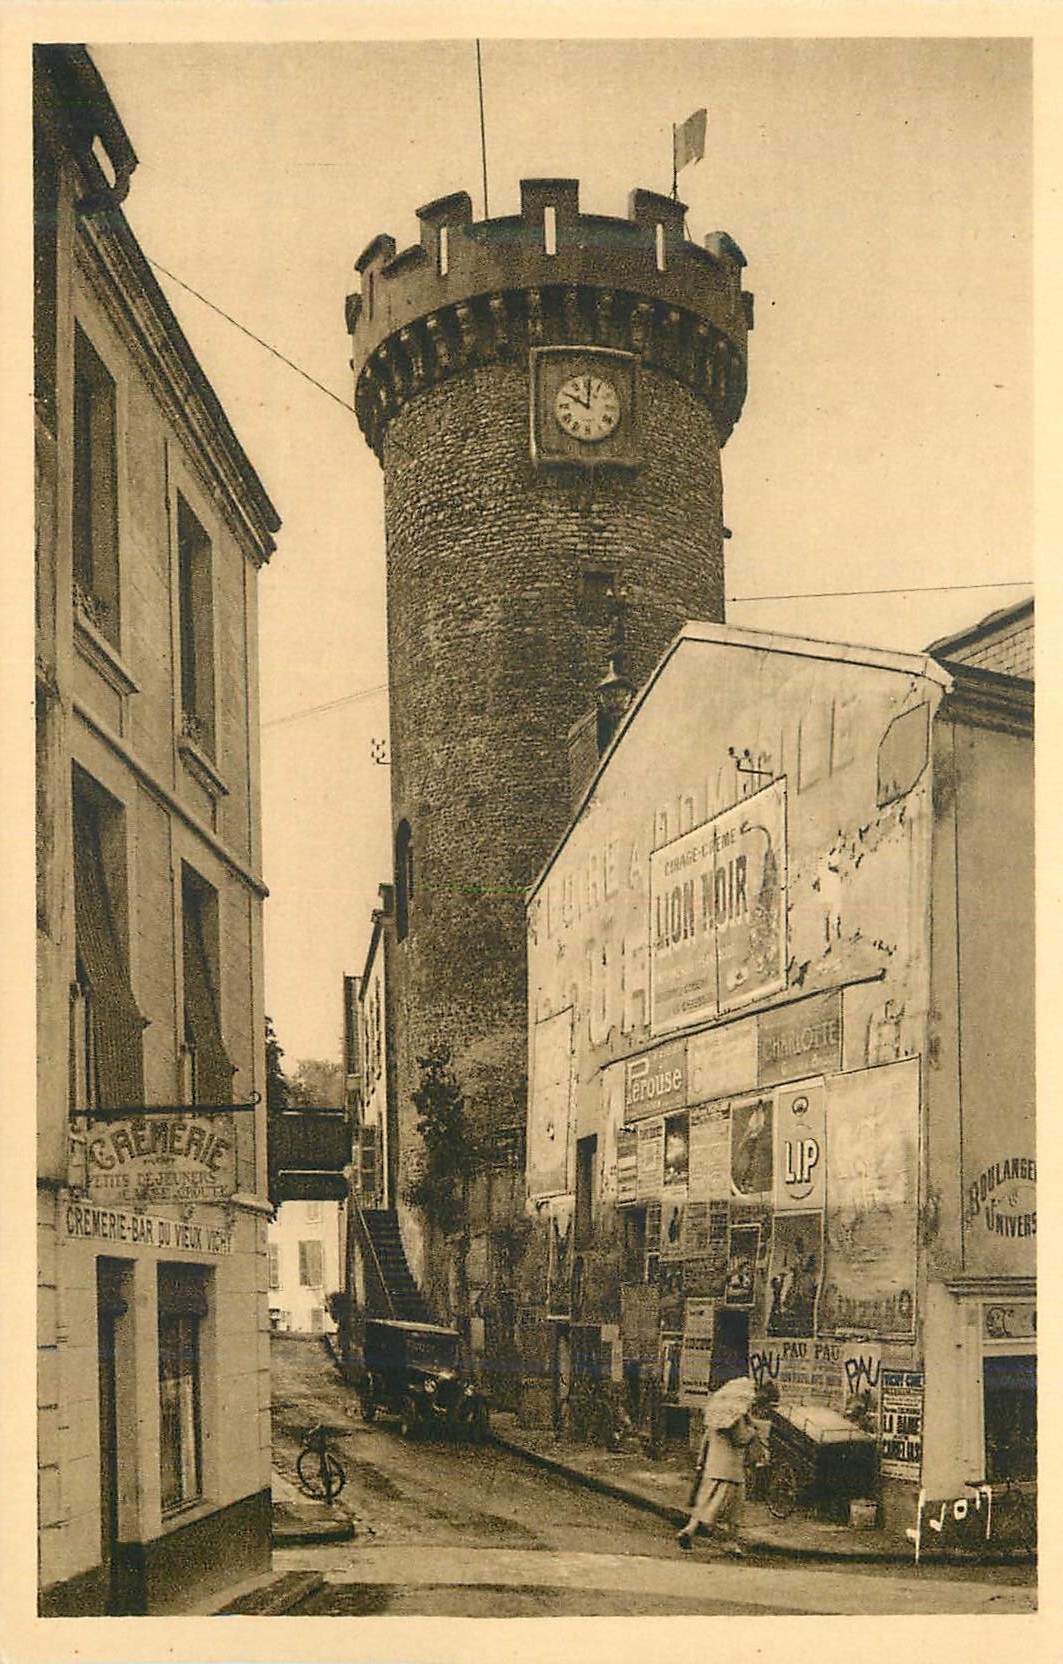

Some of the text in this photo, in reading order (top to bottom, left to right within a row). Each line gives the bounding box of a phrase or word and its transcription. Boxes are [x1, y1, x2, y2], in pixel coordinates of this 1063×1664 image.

[656, 879, 695, 948] LION
[785, 1137, 819, 1185] LIP
[969, 1157, 1037, 1217] BOULANGE
[158, 1221, 171, 1247] DU
